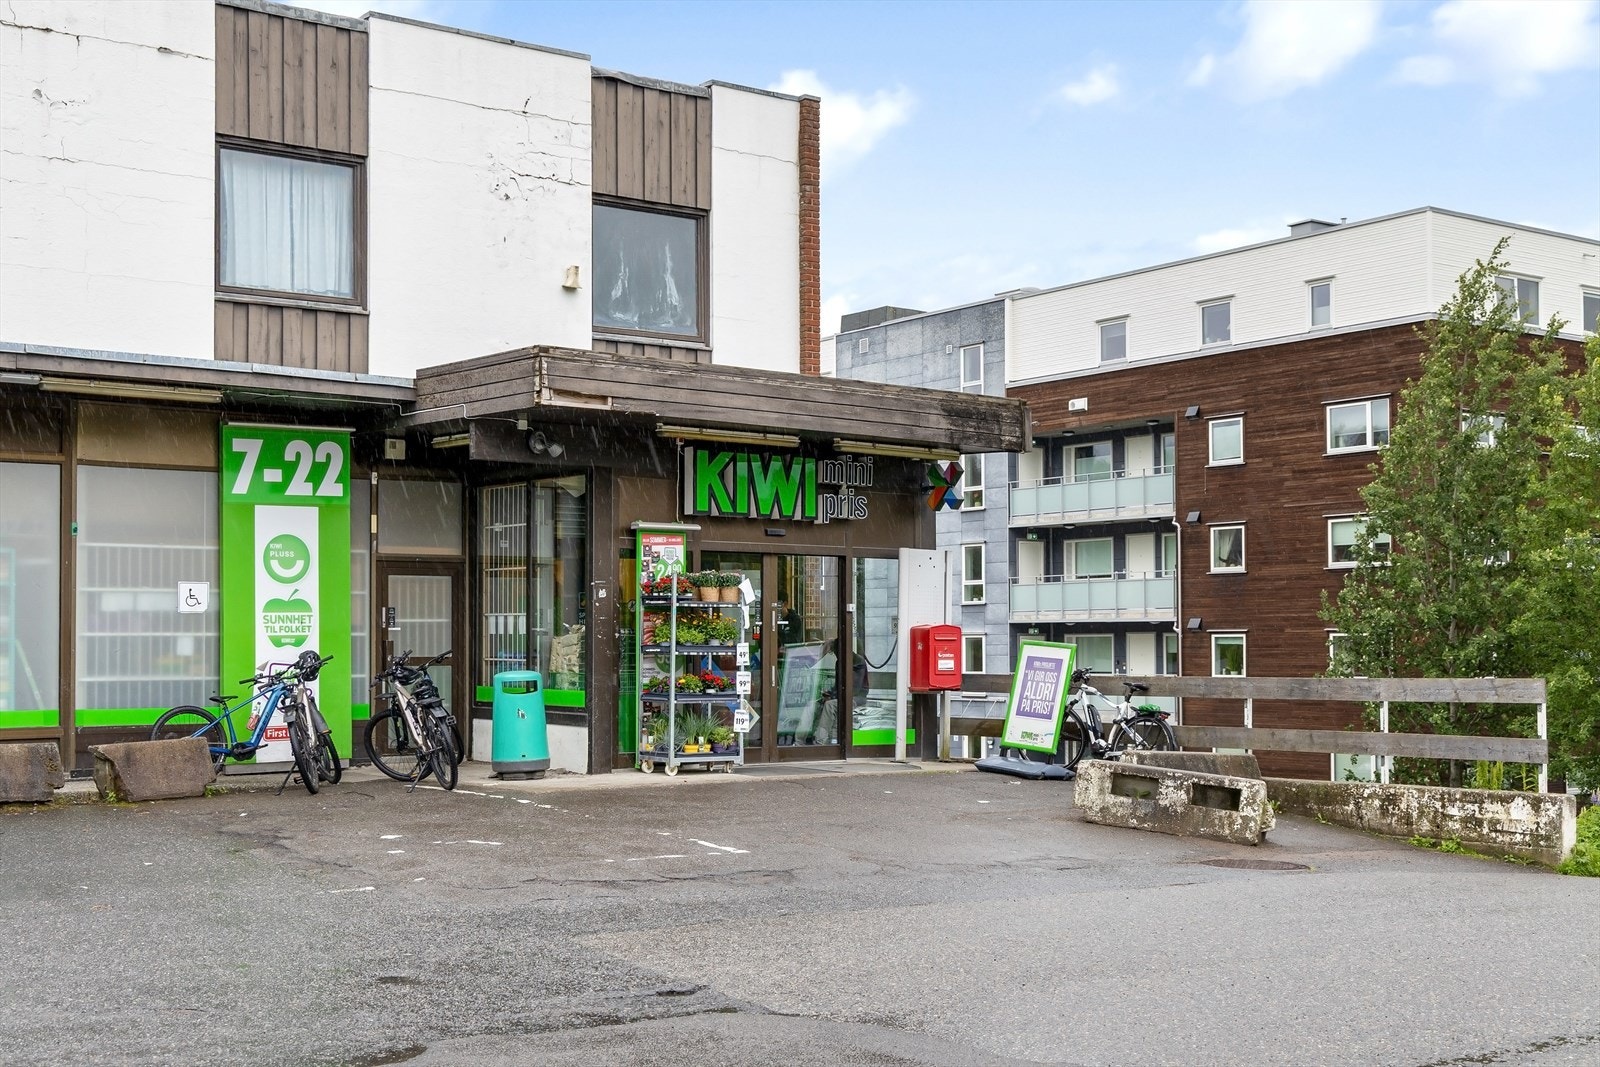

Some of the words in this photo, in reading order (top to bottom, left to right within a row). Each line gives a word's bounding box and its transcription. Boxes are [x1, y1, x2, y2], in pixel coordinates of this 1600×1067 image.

[231, 437, 344, 497] 7-22
[823, 454, 874, 487] mini
[690, 447, 818, 520] KIWI
[823, 488, 868, 524] pris
[270, 550, 295, 558] PLUSS
[262, 614, 314, 624] SUNNHET
[264, 625, 278, 634] TIL
[279, 625, 312, 633] FOLKET
[1034, 671, 1045, 682] GIR
[1045, 672, 1058, 683] OSS
[1023, 682, 1056, 700] ALDRI
[267, 729, 286, 737] First
